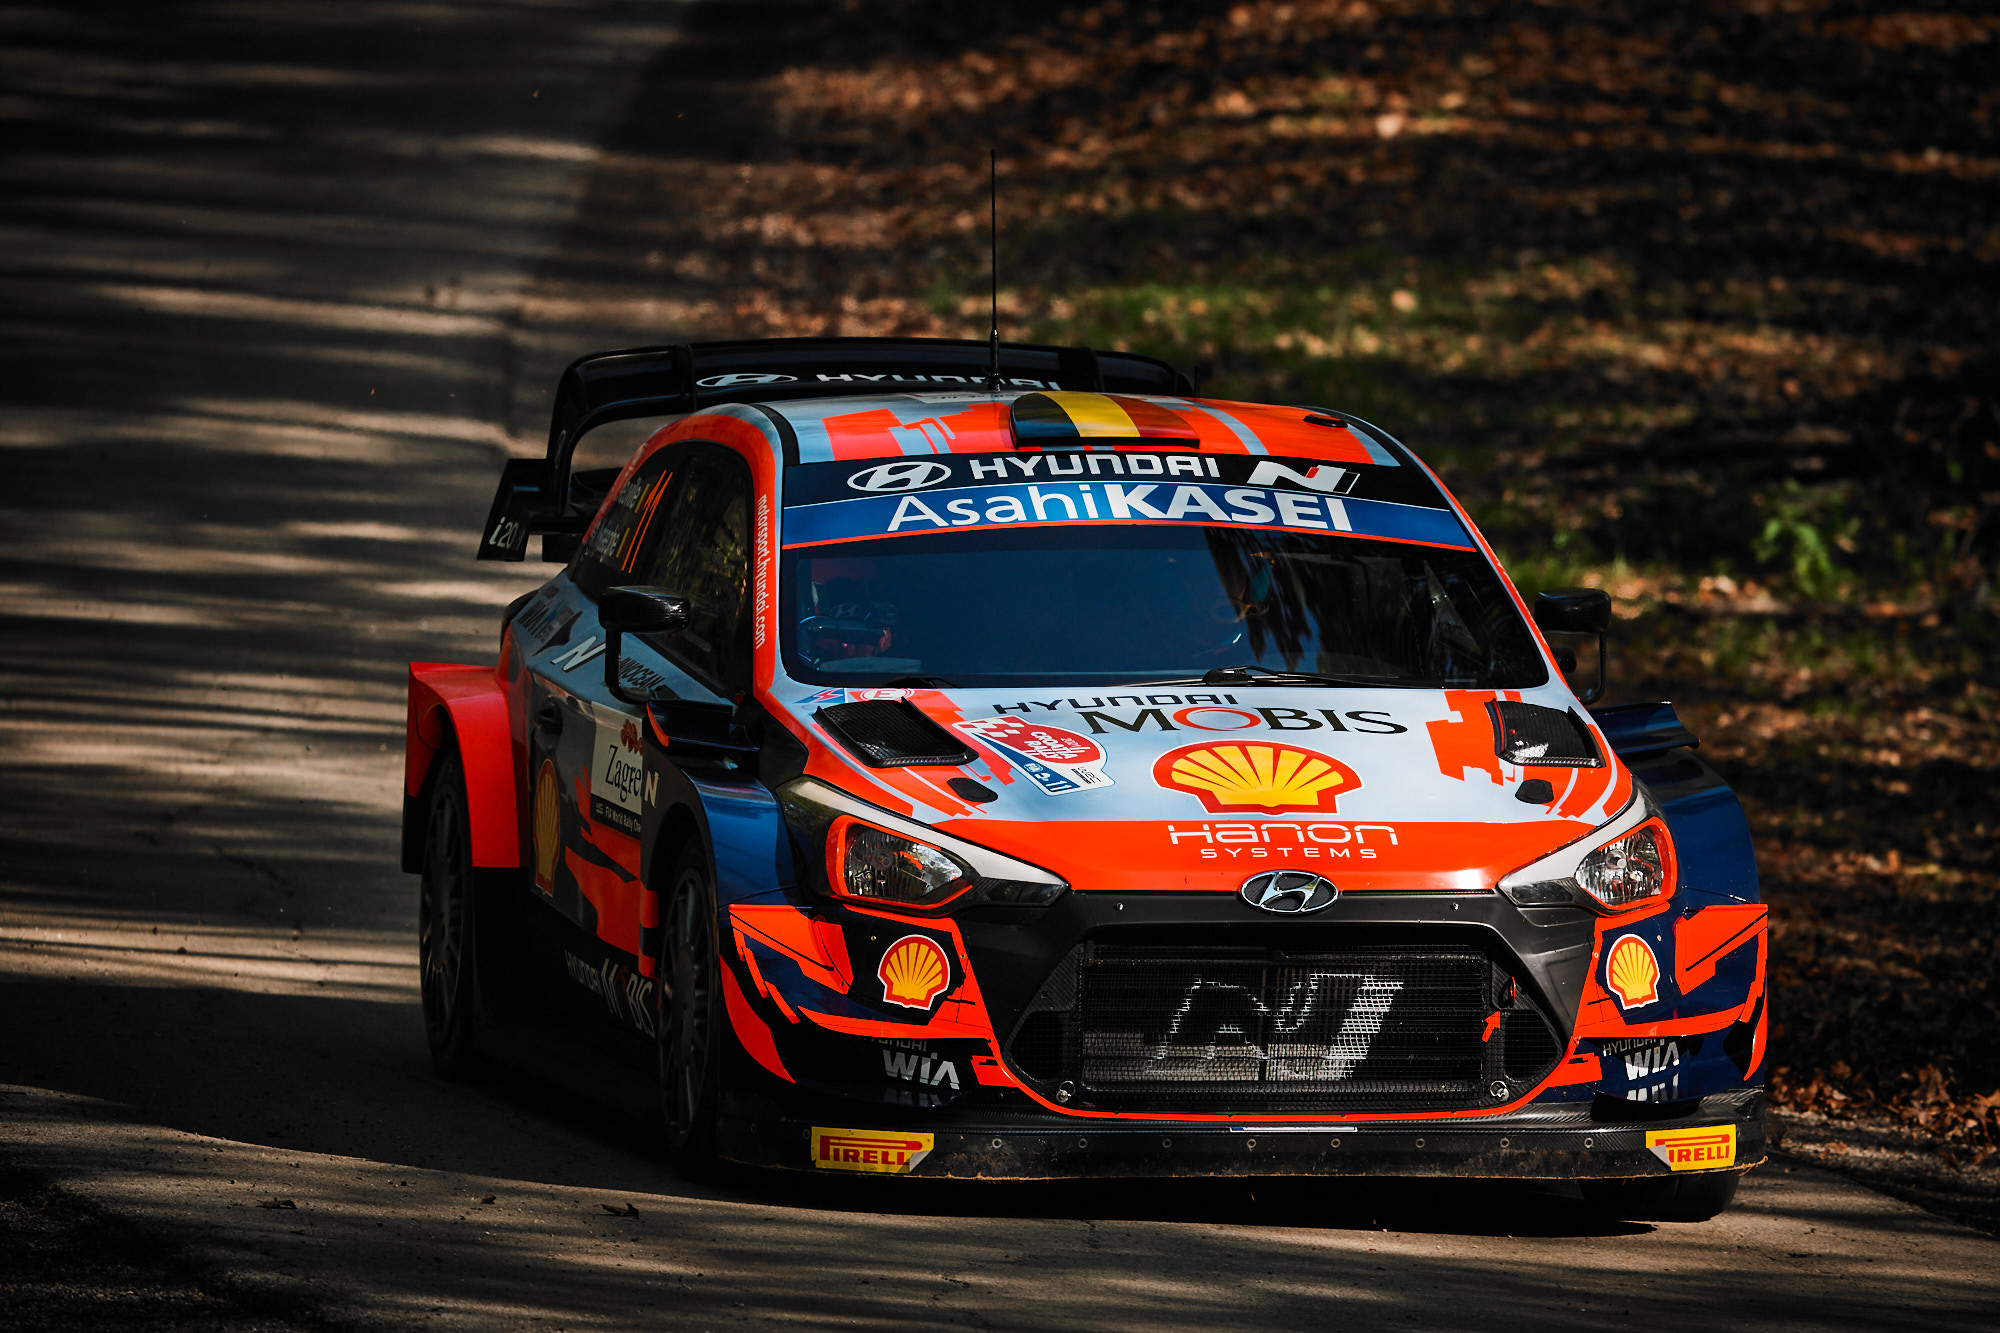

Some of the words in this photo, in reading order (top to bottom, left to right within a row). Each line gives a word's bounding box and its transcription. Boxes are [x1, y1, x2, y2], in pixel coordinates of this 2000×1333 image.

[816, 374, 1061, 391] HYUNDAI
[968, 454, 1220, 480] HYUNDAI
[622, 469, 672, 573] 11
[887, 484, 1353, 532] AsahiKASEI
[755, 494, 771, 649] motorsport.hyundai.com
[991, 694, 1239, 715] HYUNDAI
[1075, 706, 1408, 735] MOBIS
[1023, 740, 1064, 759] RALLY
[605, 744, 643, 803] Zagre
[1200, 847, 1377, 859] SYSTEMS
[819, 1135, 923, 1166] PIRELL
